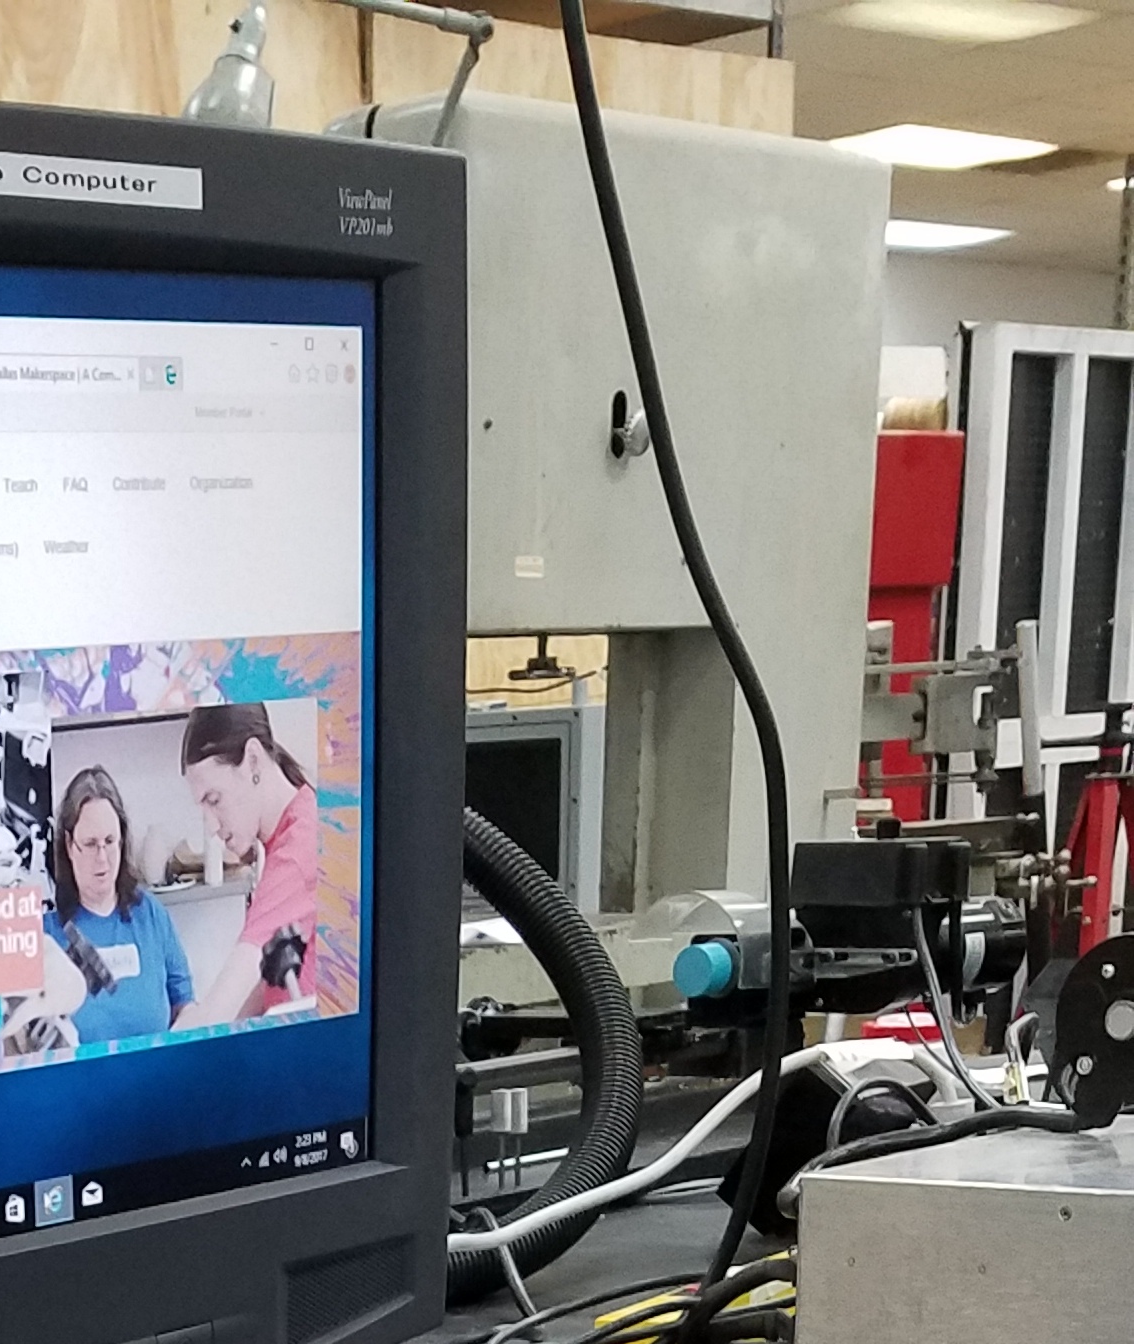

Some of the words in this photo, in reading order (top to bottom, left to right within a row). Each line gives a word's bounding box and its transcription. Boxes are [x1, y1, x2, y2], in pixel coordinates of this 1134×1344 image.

[22, 165, 158, 194] Computer
[3, 477, 39, 494] Teach
[62, 476, 89, 494] FAQ
[111, 476, 167, 492] Contribute
